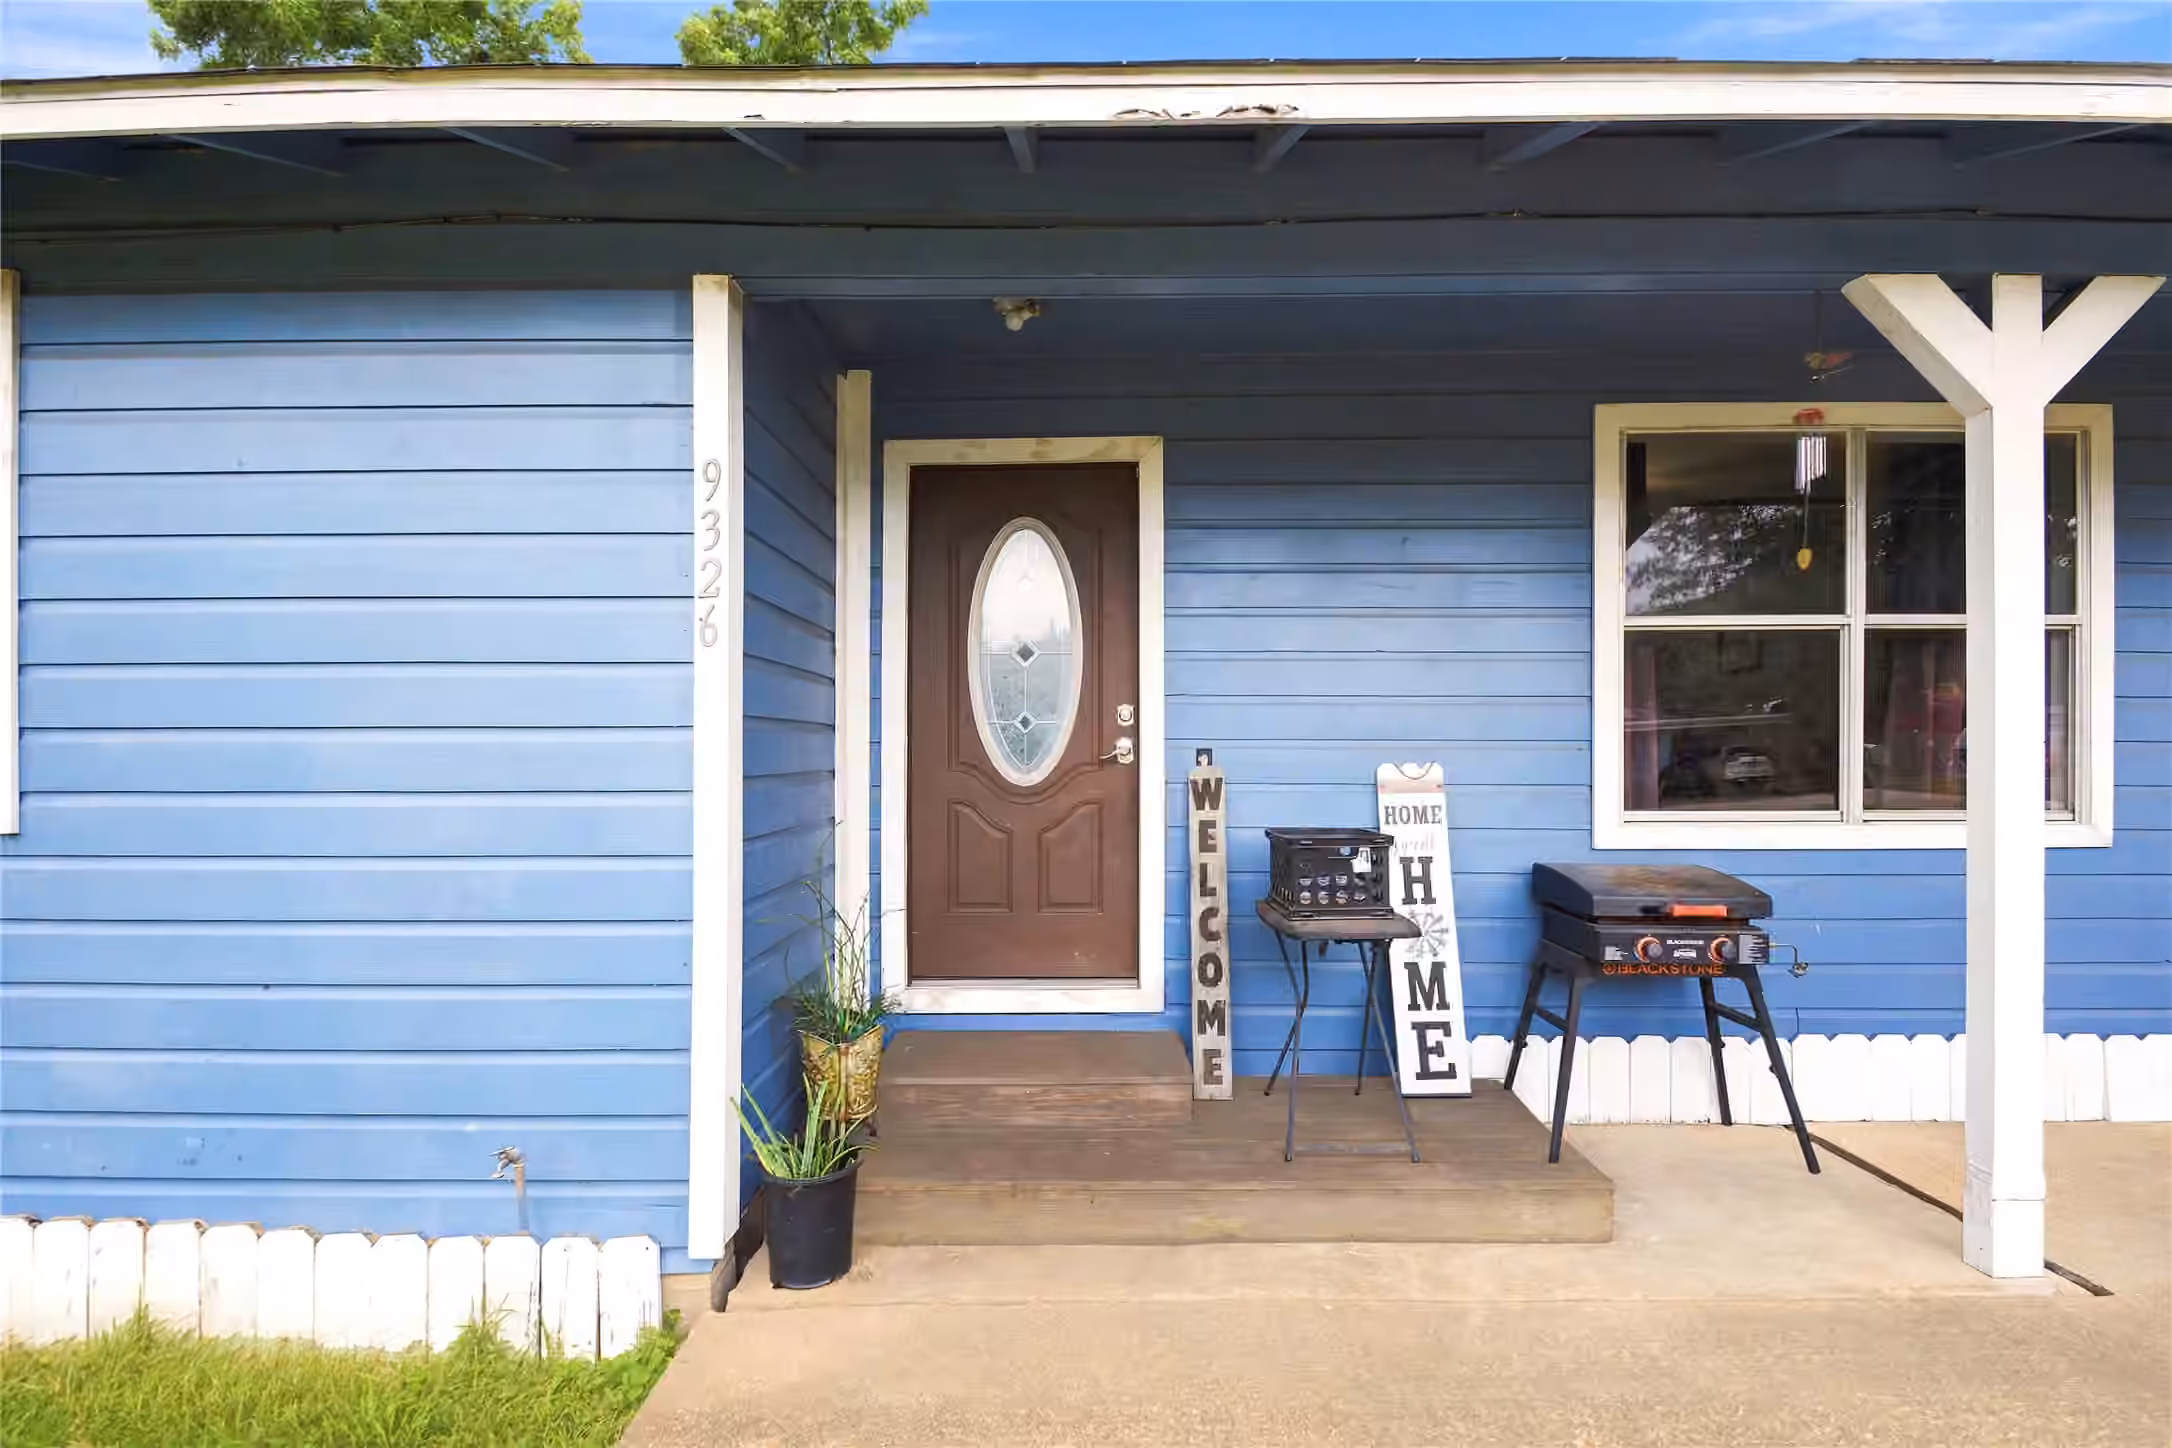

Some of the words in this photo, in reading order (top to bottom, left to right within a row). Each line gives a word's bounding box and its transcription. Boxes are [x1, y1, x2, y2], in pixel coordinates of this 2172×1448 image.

[698, 458, 722, 647] 9326
[1384, 805, 1443, 825] HOME
[1190, 777, 1226, 1086] WELCOME
[1617, 963, 1724, 975] BLACKSTONE
